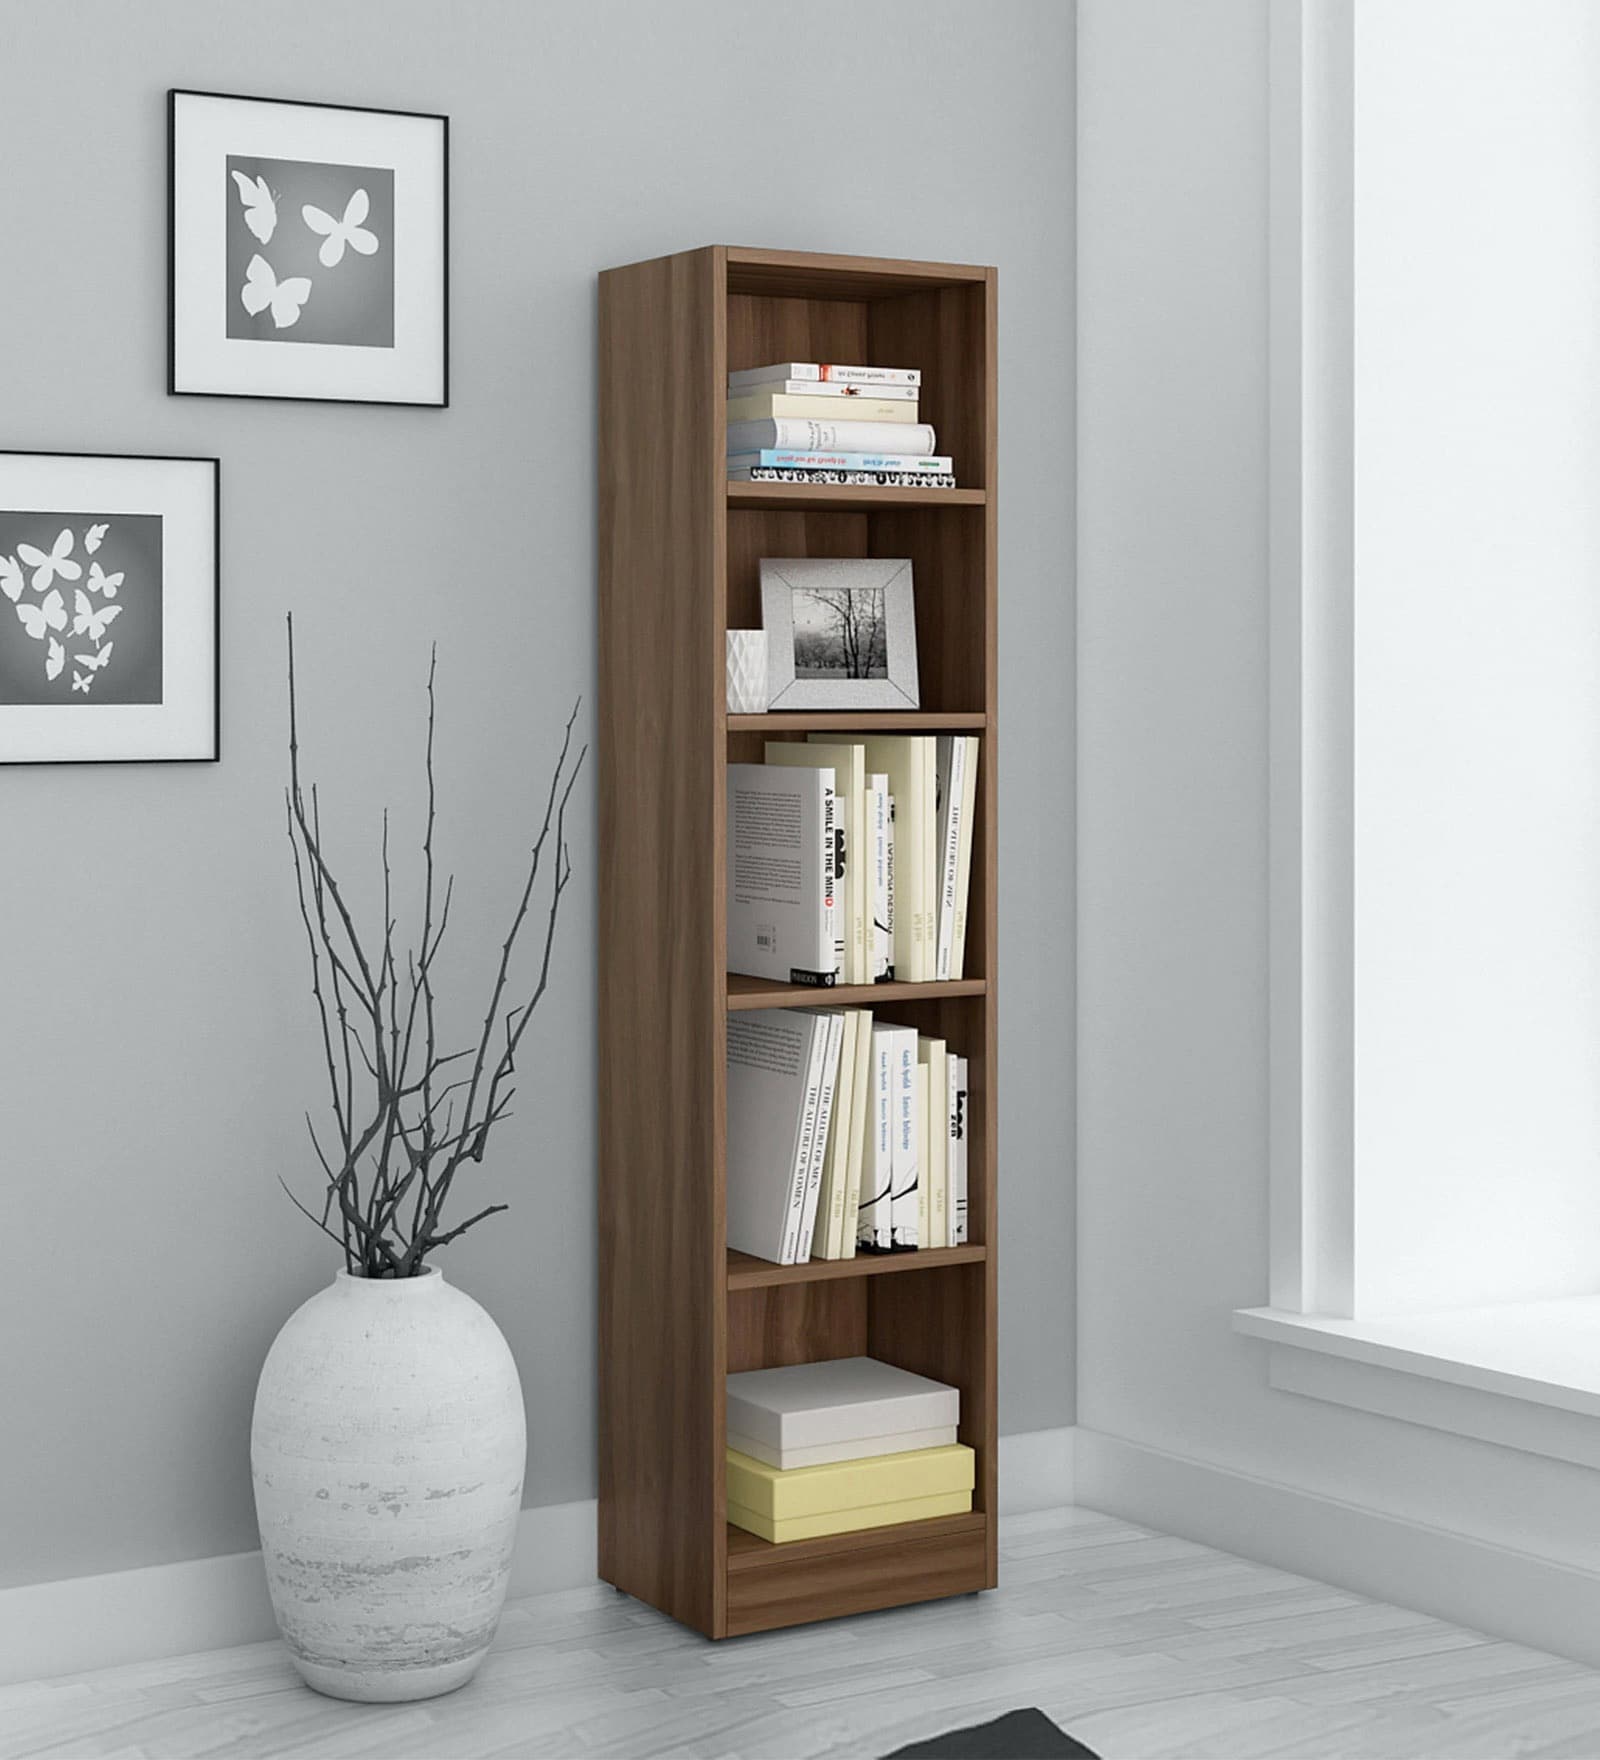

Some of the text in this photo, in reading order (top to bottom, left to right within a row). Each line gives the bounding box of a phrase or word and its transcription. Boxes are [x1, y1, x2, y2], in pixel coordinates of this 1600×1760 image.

[825, 787, 834, 797] A
[825, 799, 834, 834] SMILE
[825, 837, 834, 849] IN
[825, 853, 834, 873] THE
[825, 876, 834, 908] MIND
[792, 1087, 818, 1209] THE ALLURE OF WOMEN
[809, 1085, 832, 1189] THE ALLURE OF MEN
